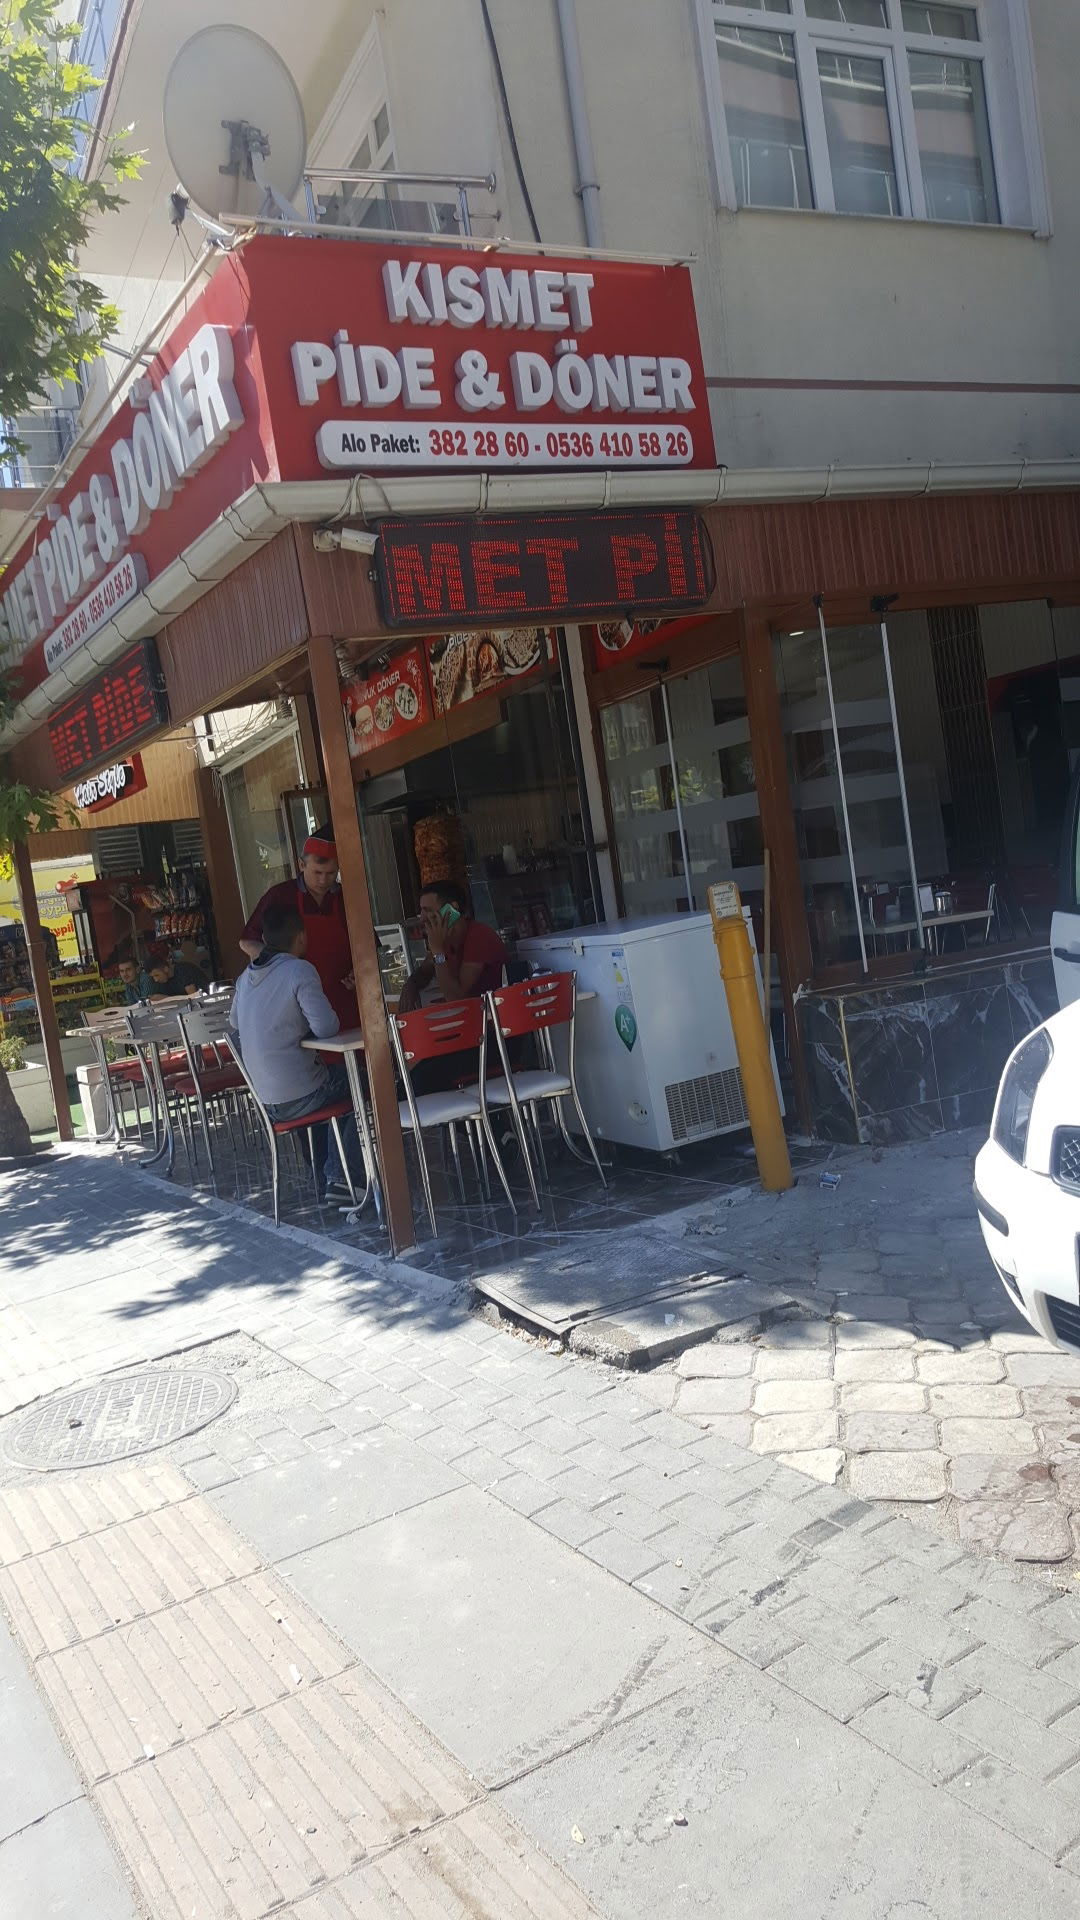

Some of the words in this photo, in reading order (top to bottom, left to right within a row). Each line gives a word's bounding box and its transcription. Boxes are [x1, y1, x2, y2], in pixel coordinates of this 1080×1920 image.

[382, 260, 595, 333] KISMET
[291, 328, 442, 410] PİDE
[454, 349, 506, 412] &
[509, 338, 697, 414] DÖNER
[89, 474, 130, 563] &
[111, 324, 244, 536] DÖNER
[341, 433, 367, 453] Alo
[370, 433, 421, 454] Paket:
[428, 429, 469, 456] 382
[473, 430, 500, 457] 28
[504, 431, 530, 457] 60
[546, 432, 594, 458] 0536
[599, 432, 634, 458] 410
[638, 432, 662, 457] 58
[665, 432, 689, 457] 26
[391, 537, 580, 615] MET
